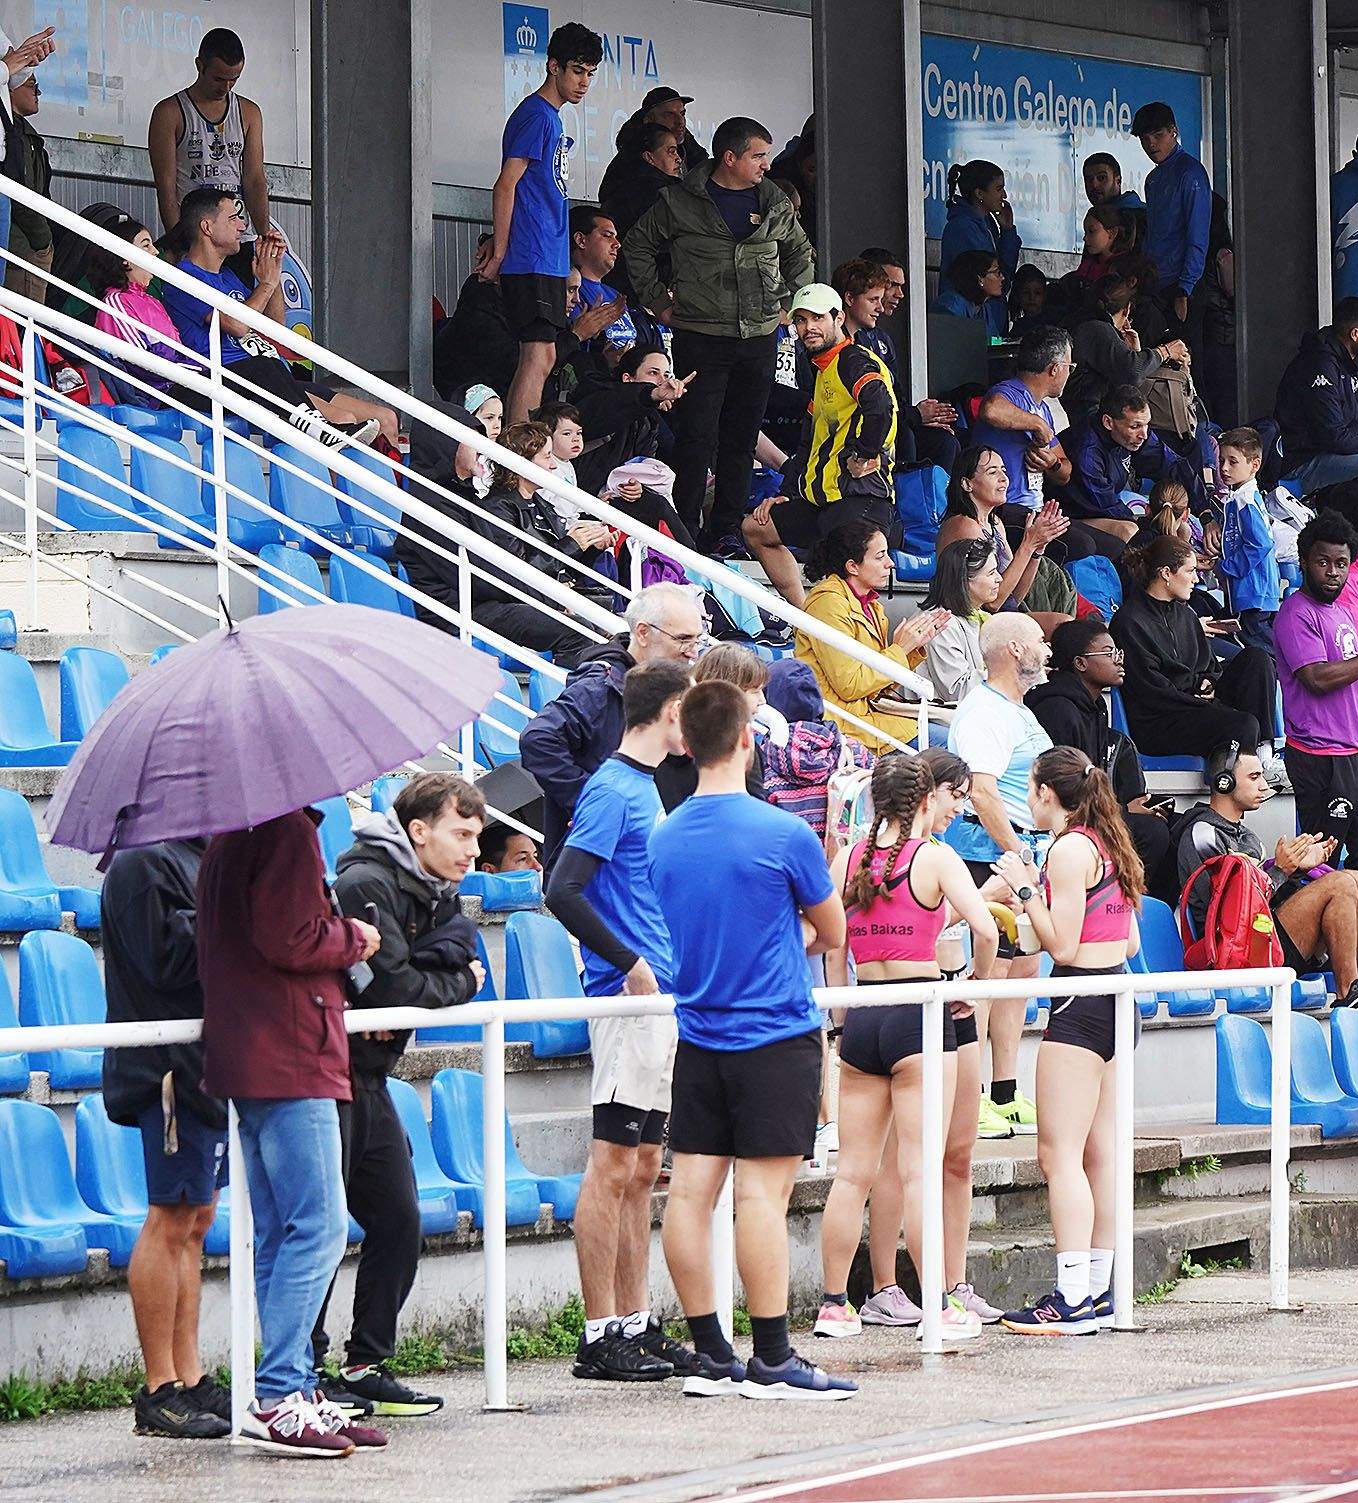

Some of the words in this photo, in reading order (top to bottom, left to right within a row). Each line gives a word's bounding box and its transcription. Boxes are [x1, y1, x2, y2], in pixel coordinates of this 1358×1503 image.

[603, 33, 661, 90] NTA
[924, 62, 1008, 125] Centro
[1013, 75, 1098, 147] Galego
[1103, 87, 1133, 141] de
[871, 923, 914, 936] Baixas
